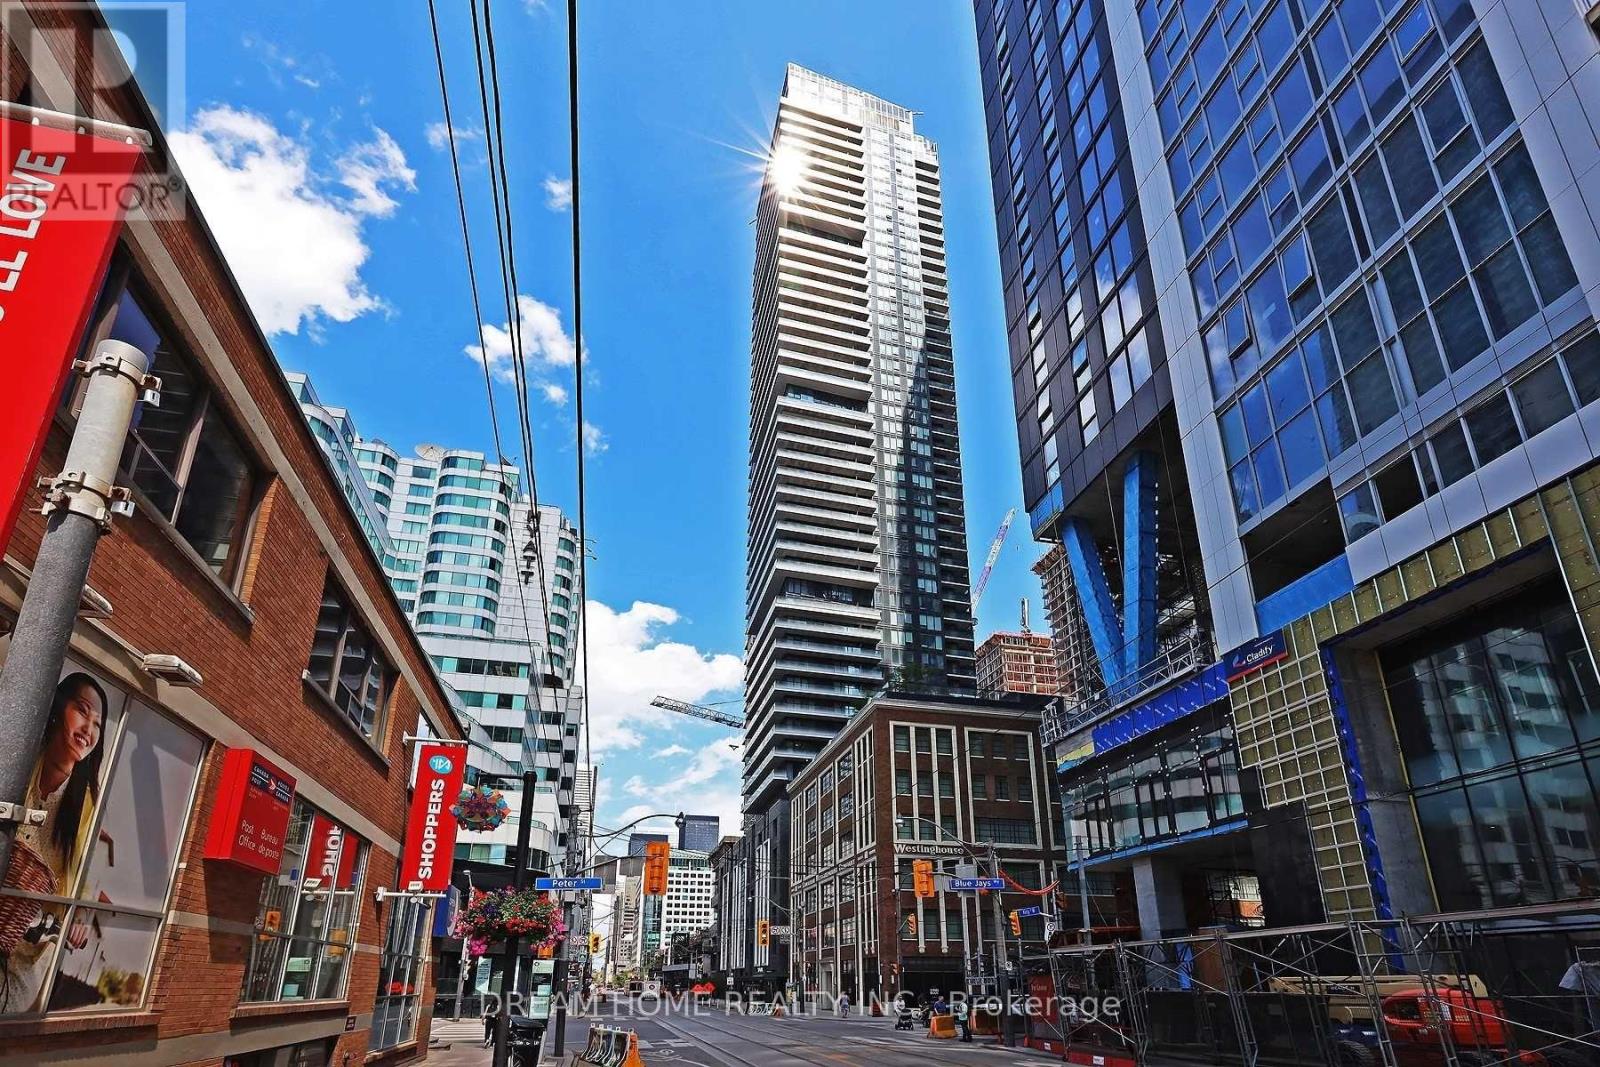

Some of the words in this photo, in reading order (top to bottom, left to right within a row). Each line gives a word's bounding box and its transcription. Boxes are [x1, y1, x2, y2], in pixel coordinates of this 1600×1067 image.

[0, 149, 67, 239] LOVE
[520, 509, 542, 586] HYATT
[1246, 645, 1273, 663] Cladify
[241, 819, 254, 835] Post
[418, 778, 445, 880] SHOPPERS
[238, 834, 256, 851] Office
[260, 828, 279, 845] Bureau
[894, 843, 965, 855] Westinghouse
[552, 879, 578, 888] Peter
[954, 880, 972, 888] Blue
[974, 880, 992, 889] Jays
